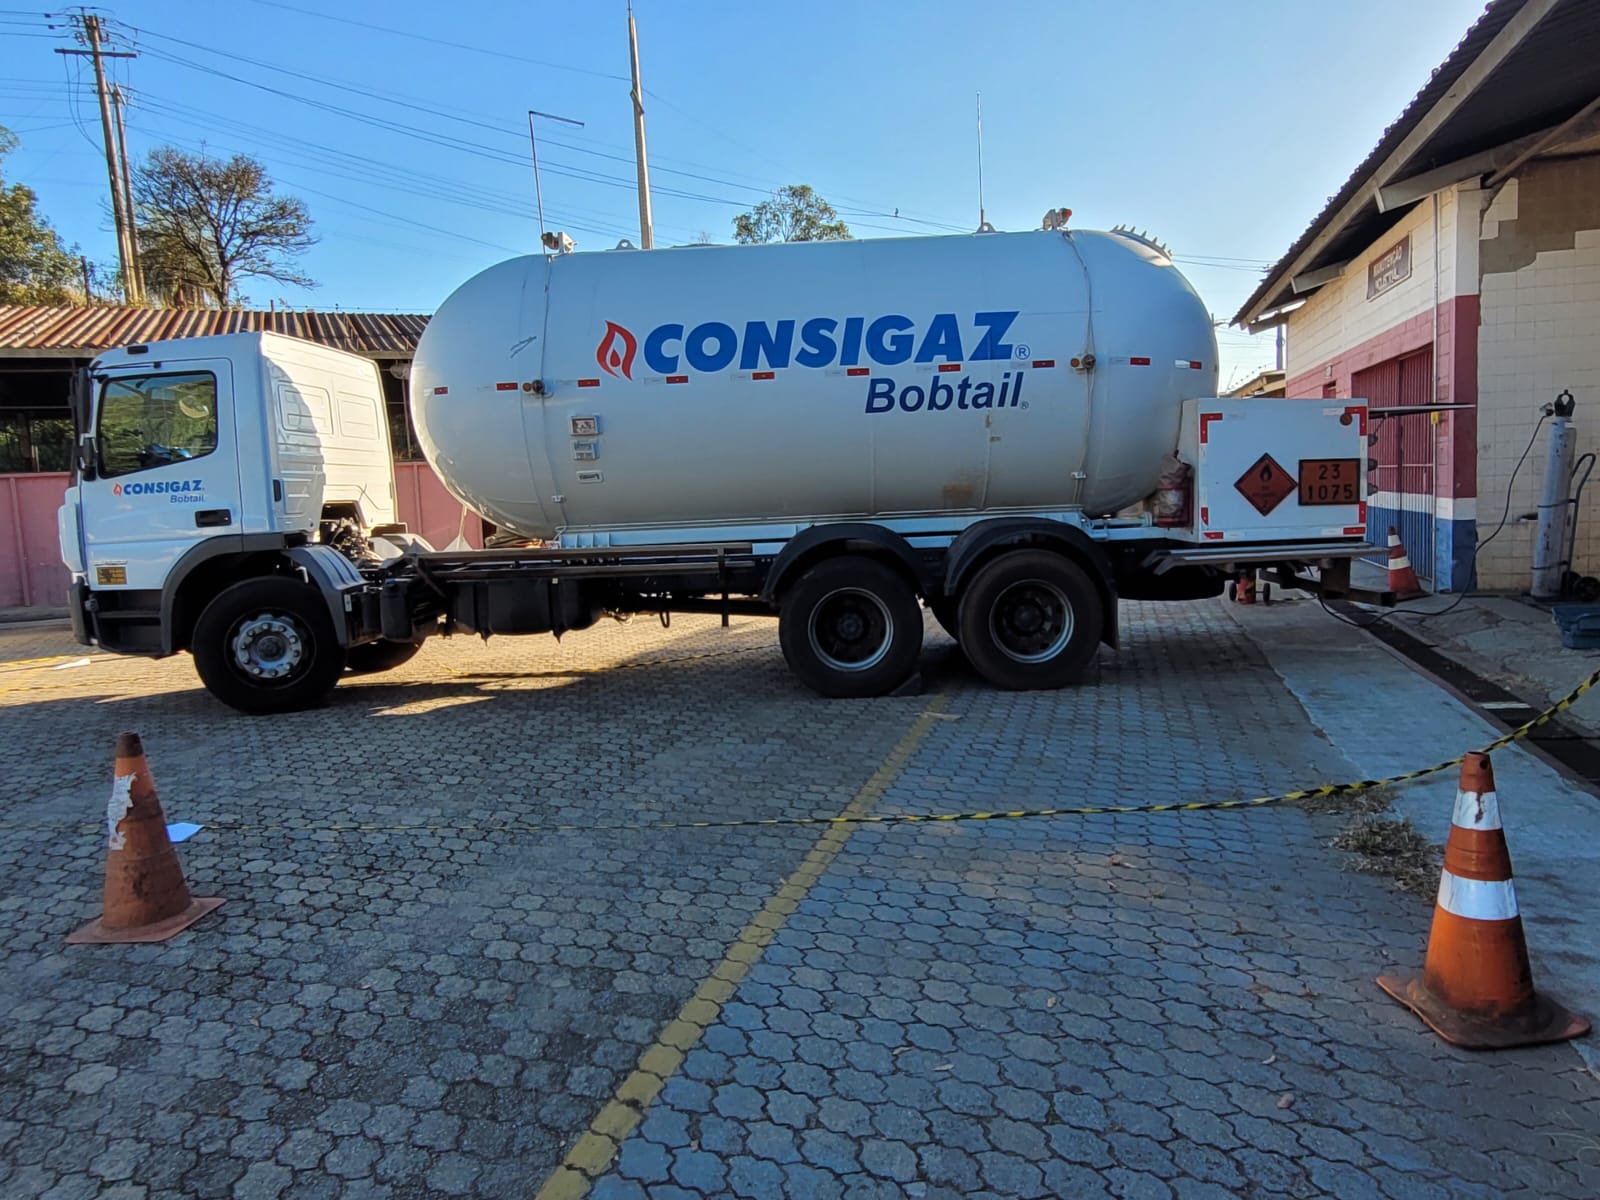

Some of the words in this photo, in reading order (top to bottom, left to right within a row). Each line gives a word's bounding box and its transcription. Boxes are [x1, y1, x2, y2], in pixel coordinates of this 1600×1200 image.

[643, 310, 1021, 374] CONSIGAZ
[864, 371, 1024, 413] Bobtail
[1318, 464, 1341, 480] 23
[123, 480, 203, 495] CONSIGAZ
[1307, 484, 1353, 500] 1075
[169, 494, 204, 503] Bobtail
